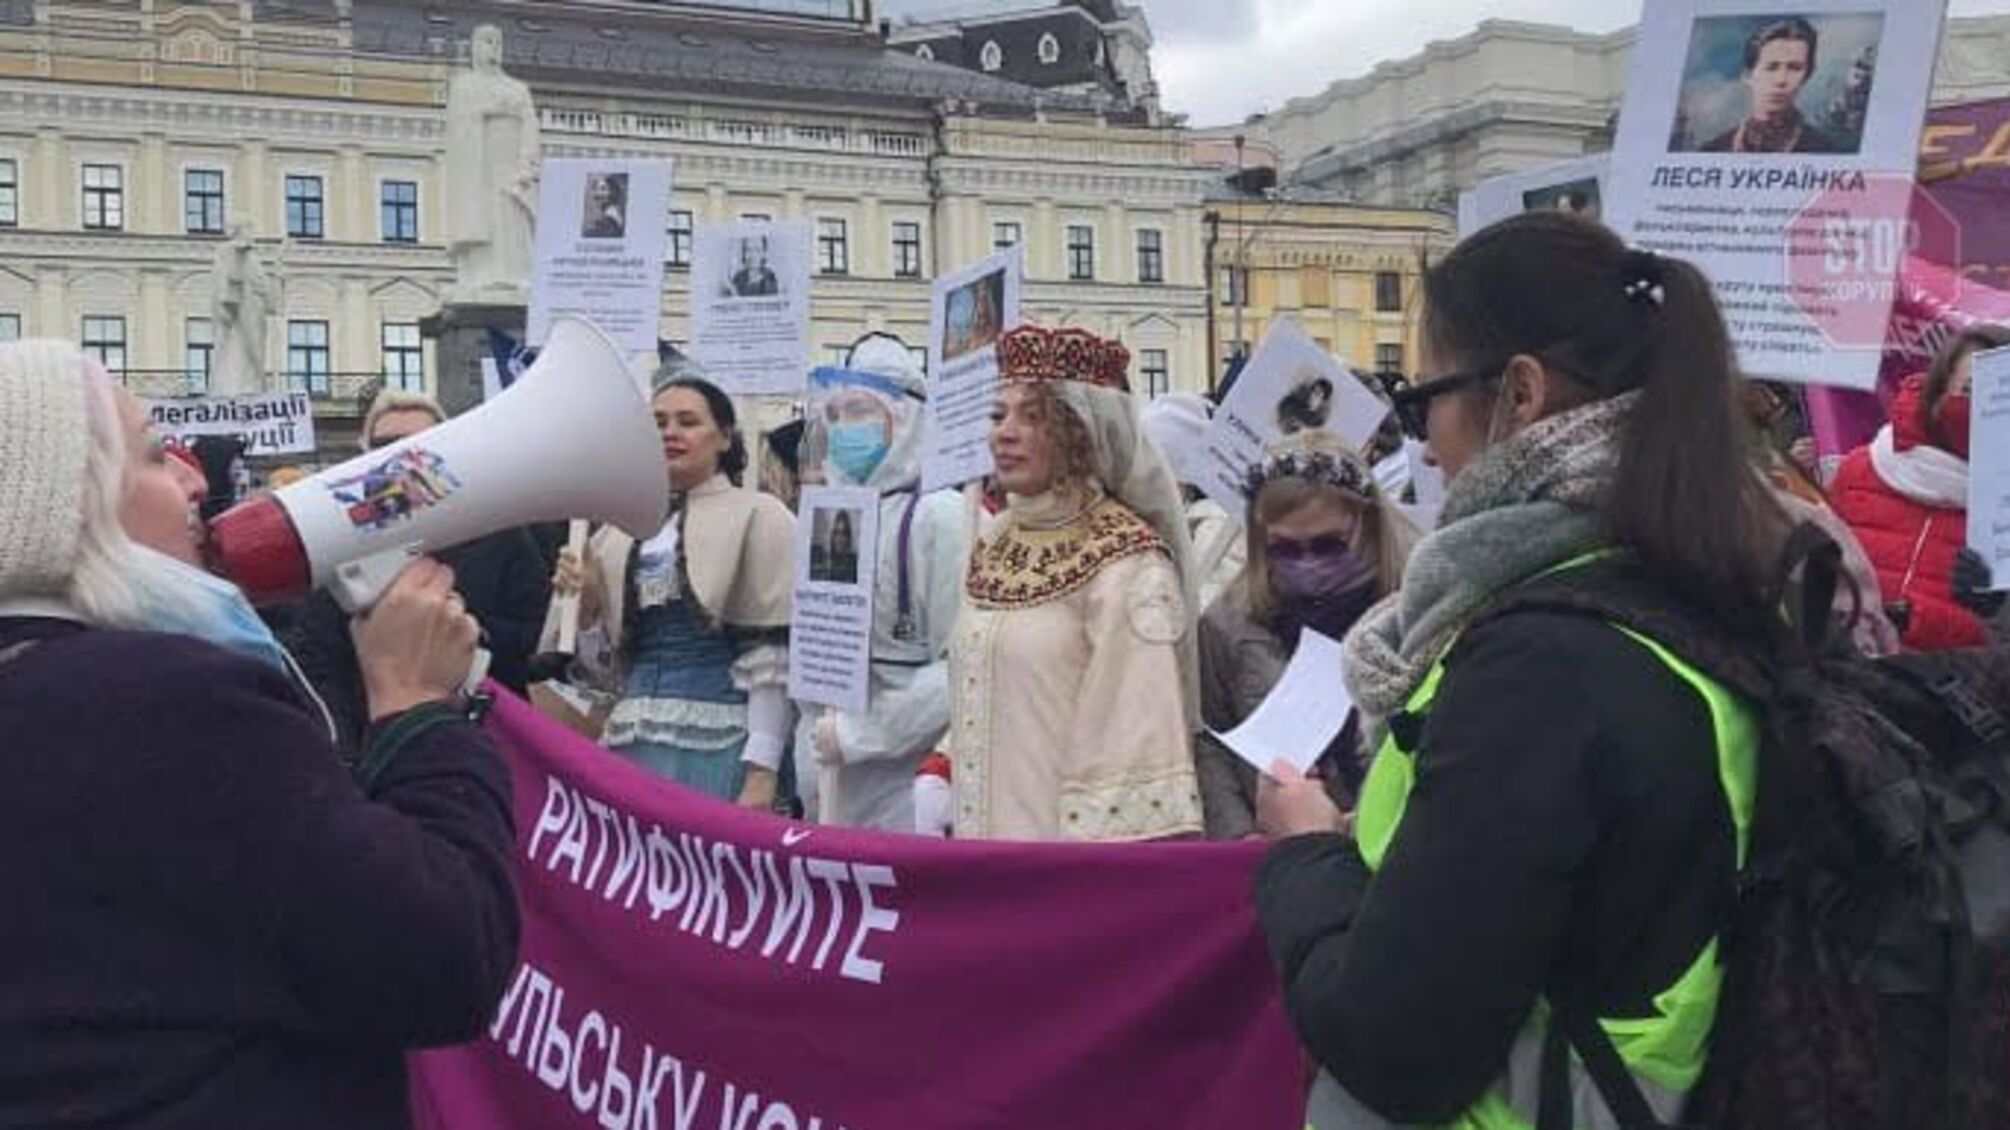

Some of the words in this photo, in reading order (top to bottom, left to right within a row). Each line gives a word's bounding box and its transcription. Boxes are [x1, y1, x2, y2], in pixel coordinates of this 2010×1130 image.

[1651, 166, 1722, 189] ЛЕСЯ
[1729, 163, 1867, 191] УКРАЇНКА
[527, 775, 900, 984] РАТИФІКУЙТЕ
